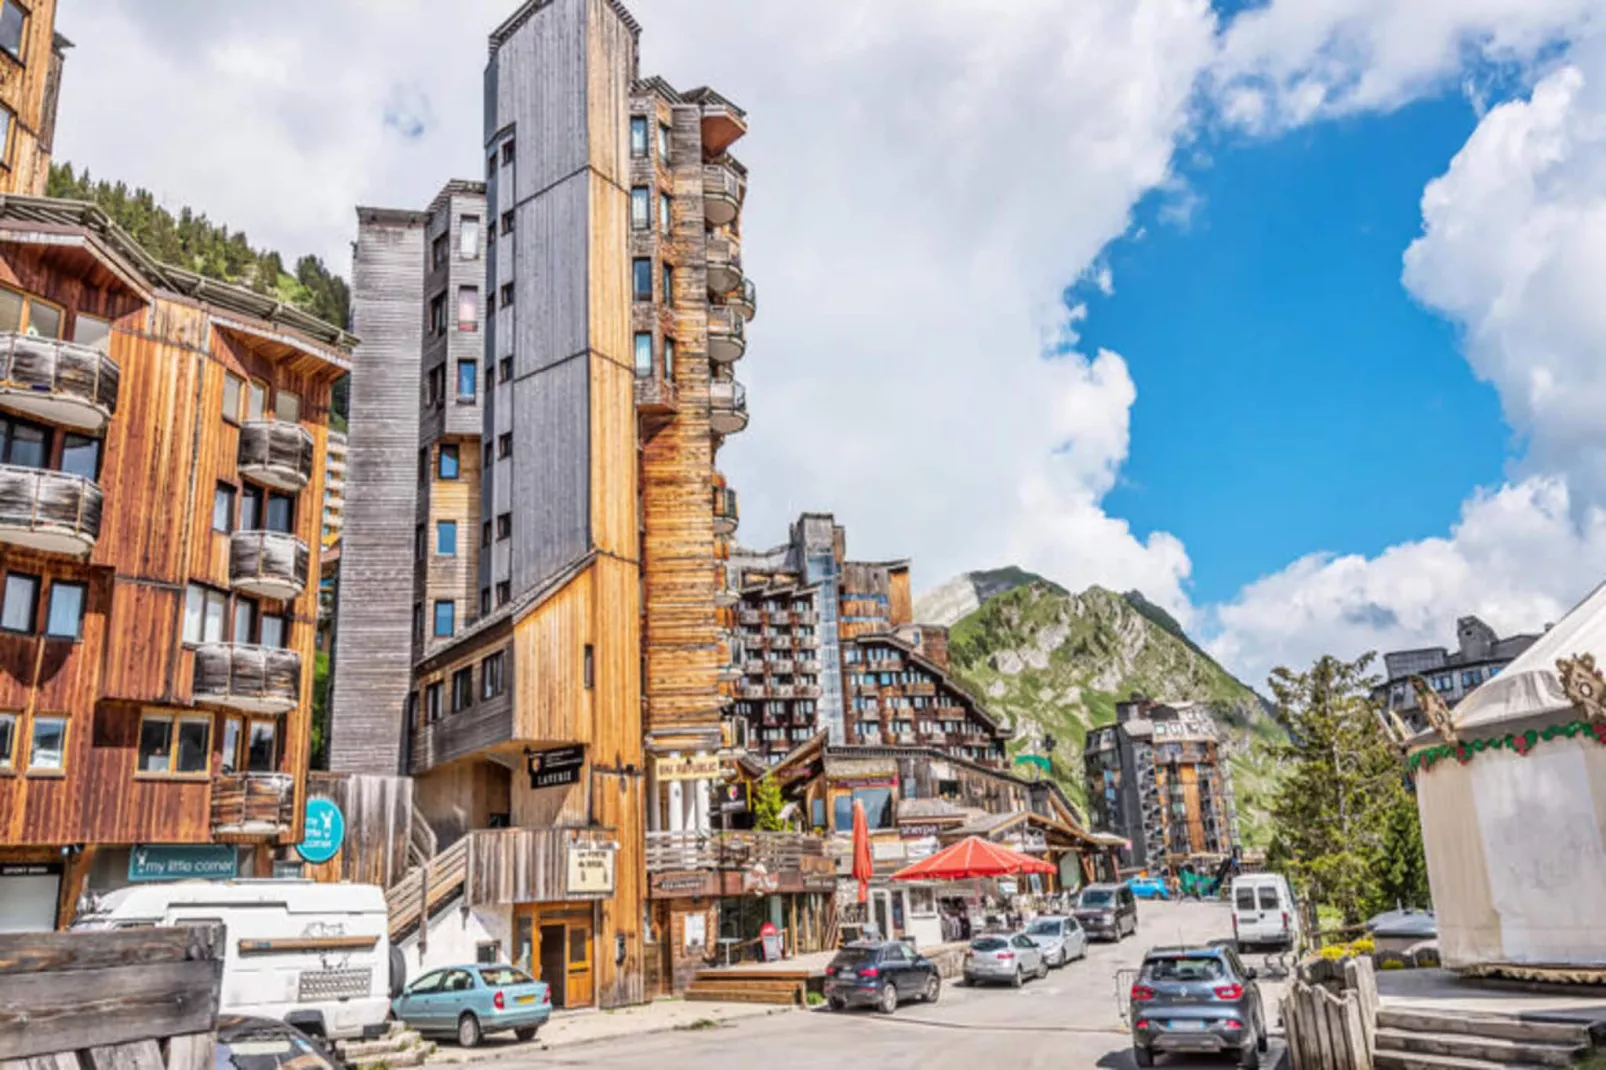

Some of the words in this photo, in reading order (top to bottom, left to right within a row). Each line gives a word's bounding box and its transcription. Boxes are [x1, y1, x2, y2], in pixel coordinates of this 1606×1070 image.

[537, 770, 571, 785] LAVERIE
[146, 862, 165, 875] my
[168, 860, 192, 872] little
[195, 861, 232, 872] corner
